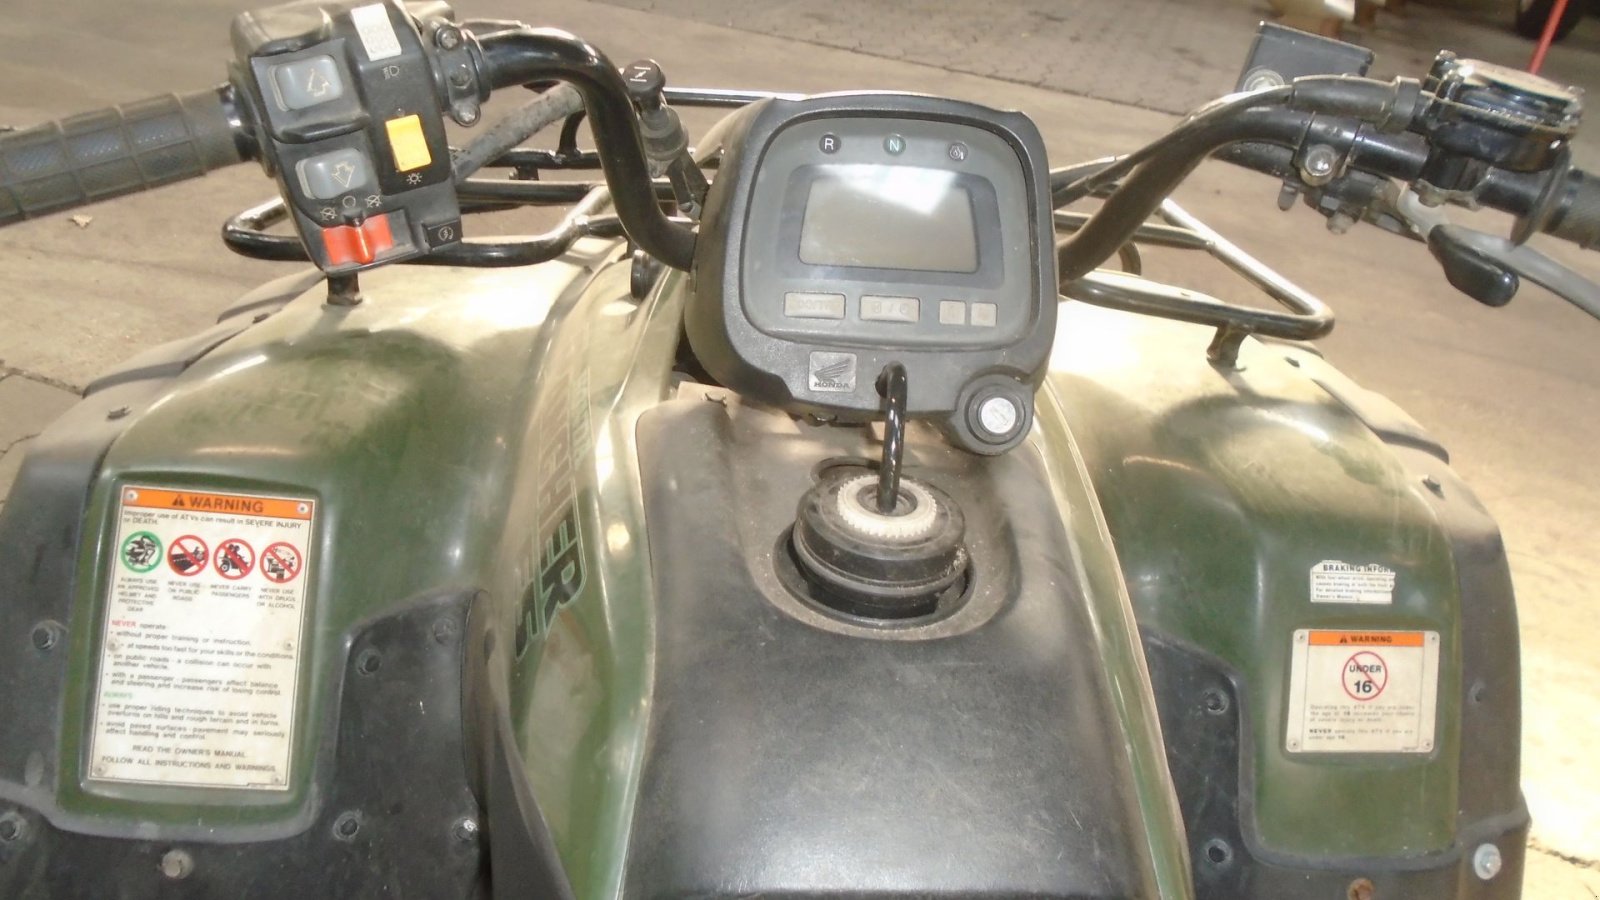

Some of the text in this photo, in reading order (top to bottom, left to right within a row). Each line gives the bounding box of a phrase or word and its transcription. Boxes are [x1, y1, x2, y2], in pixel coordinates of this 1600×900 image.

[824, 138, 834, 150] R
[889, 140, 900, 152] N
[190, 496, 264, 513] WARNING
[124, 510, 154, 519] Improper
[1323, 564, 1361, 572] BRAKING
[171, 634, 199, 642] training
[1350, 635, 1392, 643] WARNING
[125, 654, 145, 662] public
[1349, 664, 1381, 673] UNDER
[1354, 680, 1372, 693] 16
[174, 747, 210, 756] OWNER'S
[101, 756, 133, 764] FOLLOW
[154, 759, 211, 768] INSTRUCTIONS
